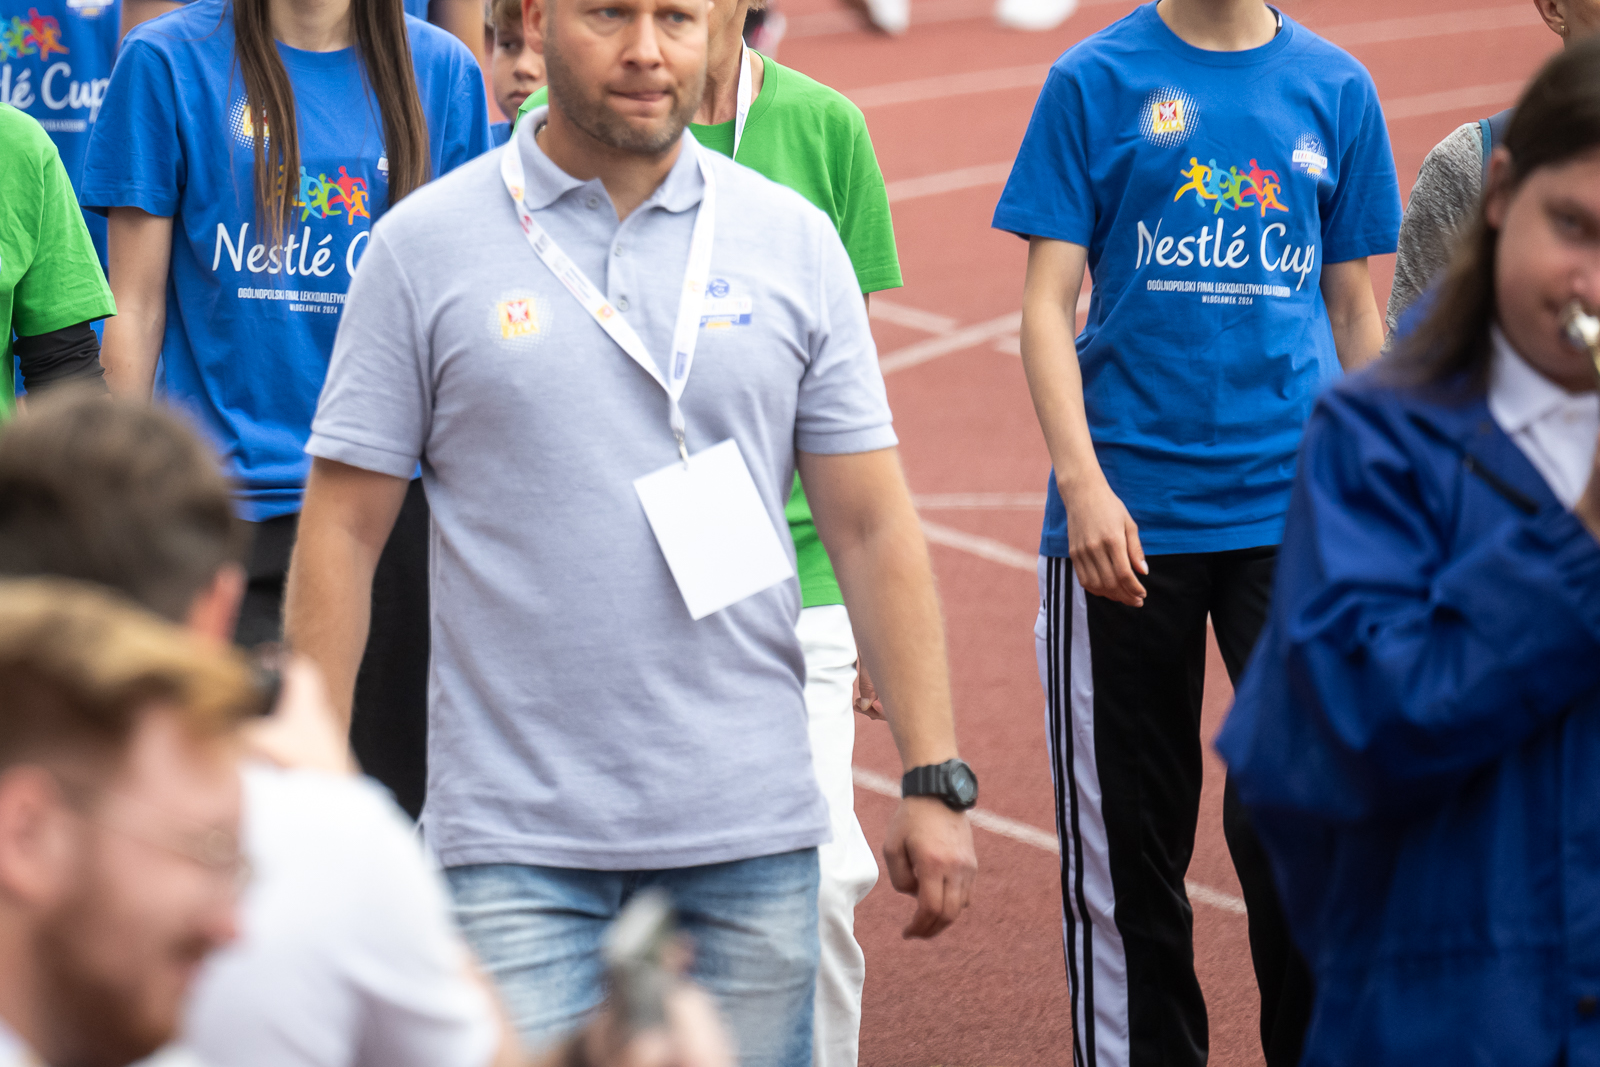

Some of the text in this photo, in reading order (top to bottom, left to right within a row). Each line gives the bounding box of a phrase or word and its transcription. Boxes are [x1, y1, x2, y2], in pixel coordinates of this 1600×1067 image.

[41, 61, 110, 124] Cup
[212, 223, 335, 277] Nestlé
[1135, 218, 1315, 291] Nestlé Cup
[238, 287, 284, 300] OGÓLNOPOLSKI
[323, 305, 338, 314] 2024
